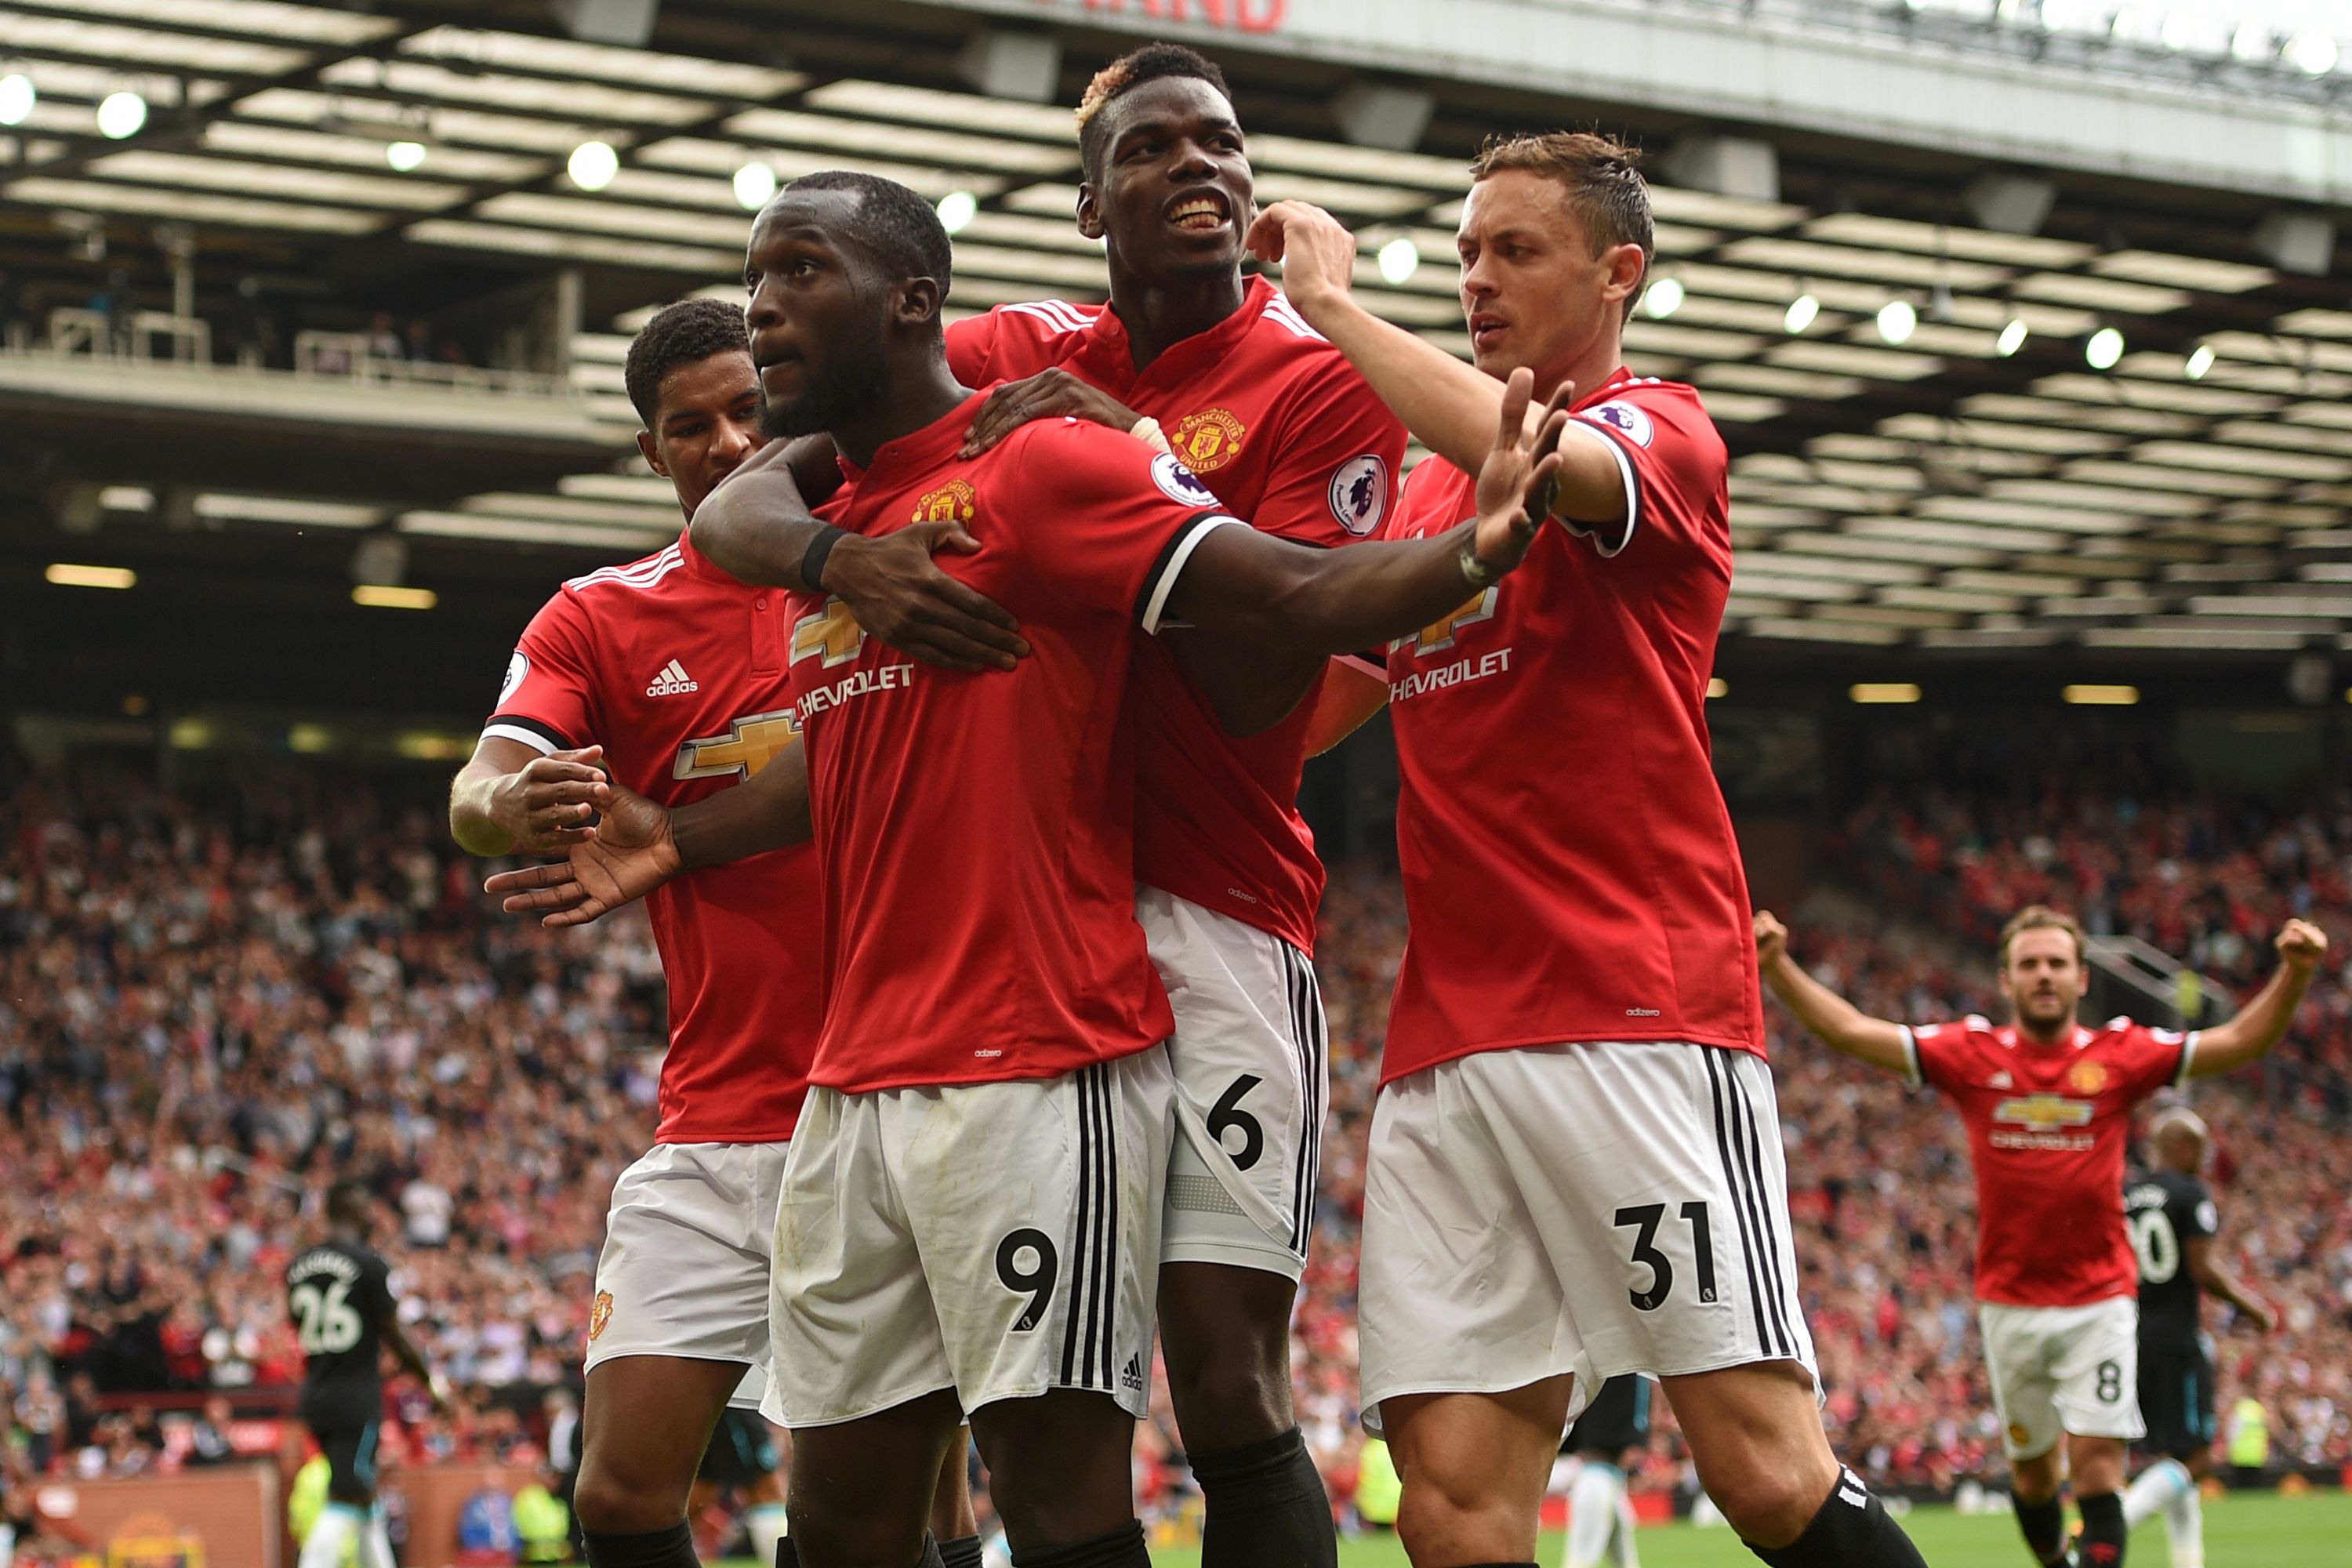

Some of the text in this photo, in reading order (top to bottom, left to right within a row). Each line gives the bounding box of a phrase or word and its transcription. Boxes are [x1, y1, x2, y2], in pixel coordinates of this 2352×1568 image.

[1186, 412, 1239, 438] MANCHESTER
[1179, 454, 1218, 470] UNITED
[646, 681, 699, 697] adidas
[1388, 648, 1512, 703] HEVROLET
[1207, 1073, 1263, 1171] 6
[996, 1227, 1058, 1332] 9
[1613, 1201, 1719, 1312] 31
[289, 1279, 364, 1355] 26
[2096, 1360, 2121, 1404] 8
